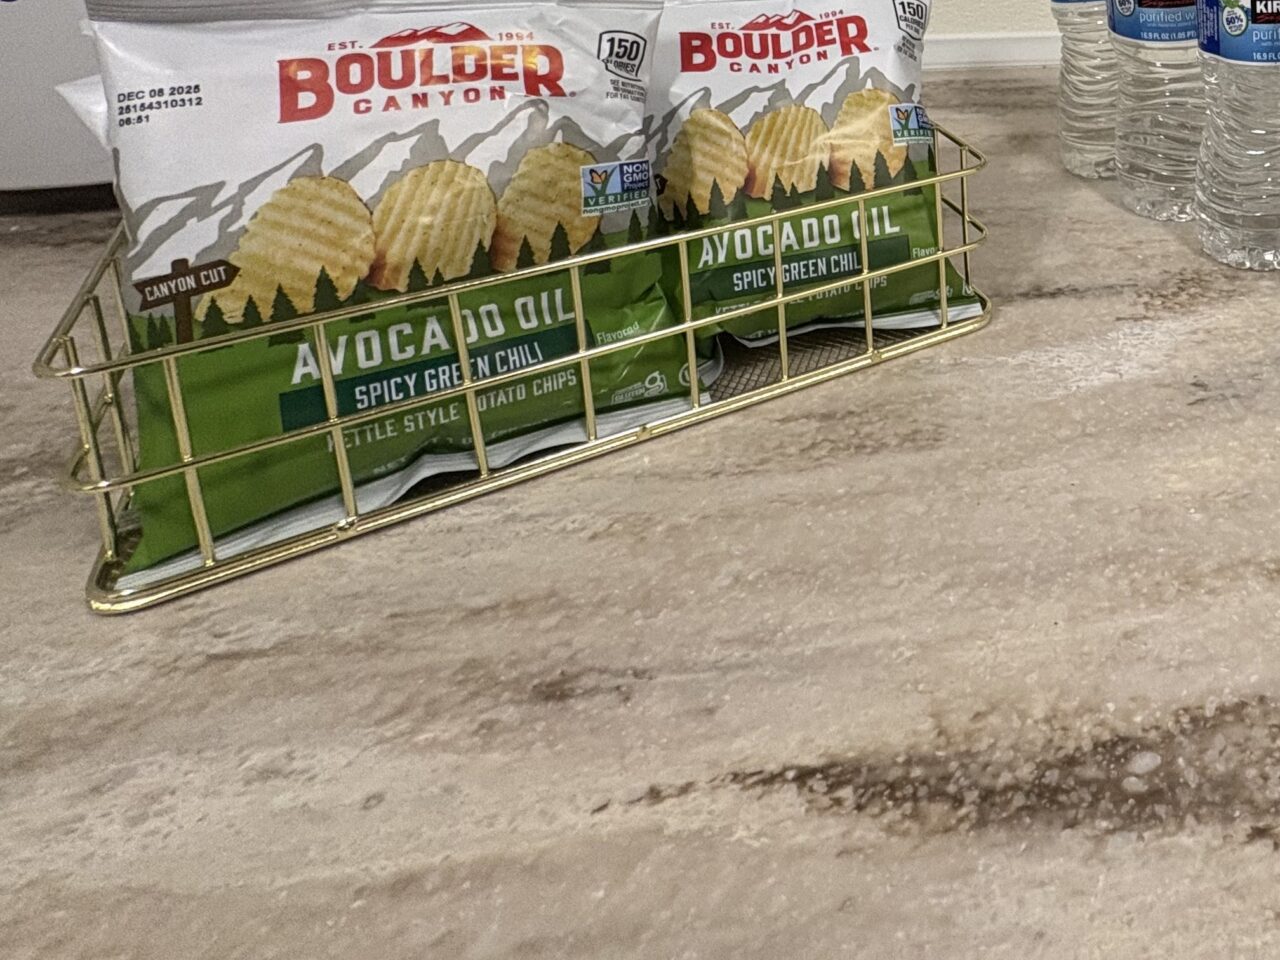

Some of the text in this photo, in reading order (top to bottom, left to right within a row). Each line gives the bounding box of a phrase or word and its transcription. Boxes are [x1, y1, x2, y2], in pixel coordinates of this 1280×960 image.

[711, 9, 844, 30] EST. 1994
[898, 0, 924, 20] 150
[1140, 10, 1182, 24] purified
[327, 31, 535, 51] EST. 1994
[606, 36, 641, 62] 150
[679, 15, 872, 72] BOULDER
[729, 50, 828, 75] CANYON
[1252, 52, 1267, 60] 16.9
[1268, 52, 1276, 60] FL
[117, 84, 201, 103] DEC 08 2025
[276, 44, 570, 124] BOULDER
[353, 85, 507, 115] CANYON
[623, 163, 649, 174] NON
[623, 172, 649, 183] GMO
[588, 190, 647, 206] VERIFIED
[624, 181, 649, 191] Project
[697, 205, 900, 269] AVOCADO OIL
[912, 246, 938, 258] Flavo
[144, 263, 228, 300] CANYON CUT
[733, 250, 862, 291] SPICY GREEN CHIL
[291, 287, 577, 385] AVOCADO OIL
[596, 321, 640, 345] Flavored
[354, 372, 418, 410] SPICY
[495, 341, 544, 373] CHILI
[403, 402, 461, 433] STYLE
[476, 383, 528, 412] OTATO
[533, 368, 578, 397] CHIPS
